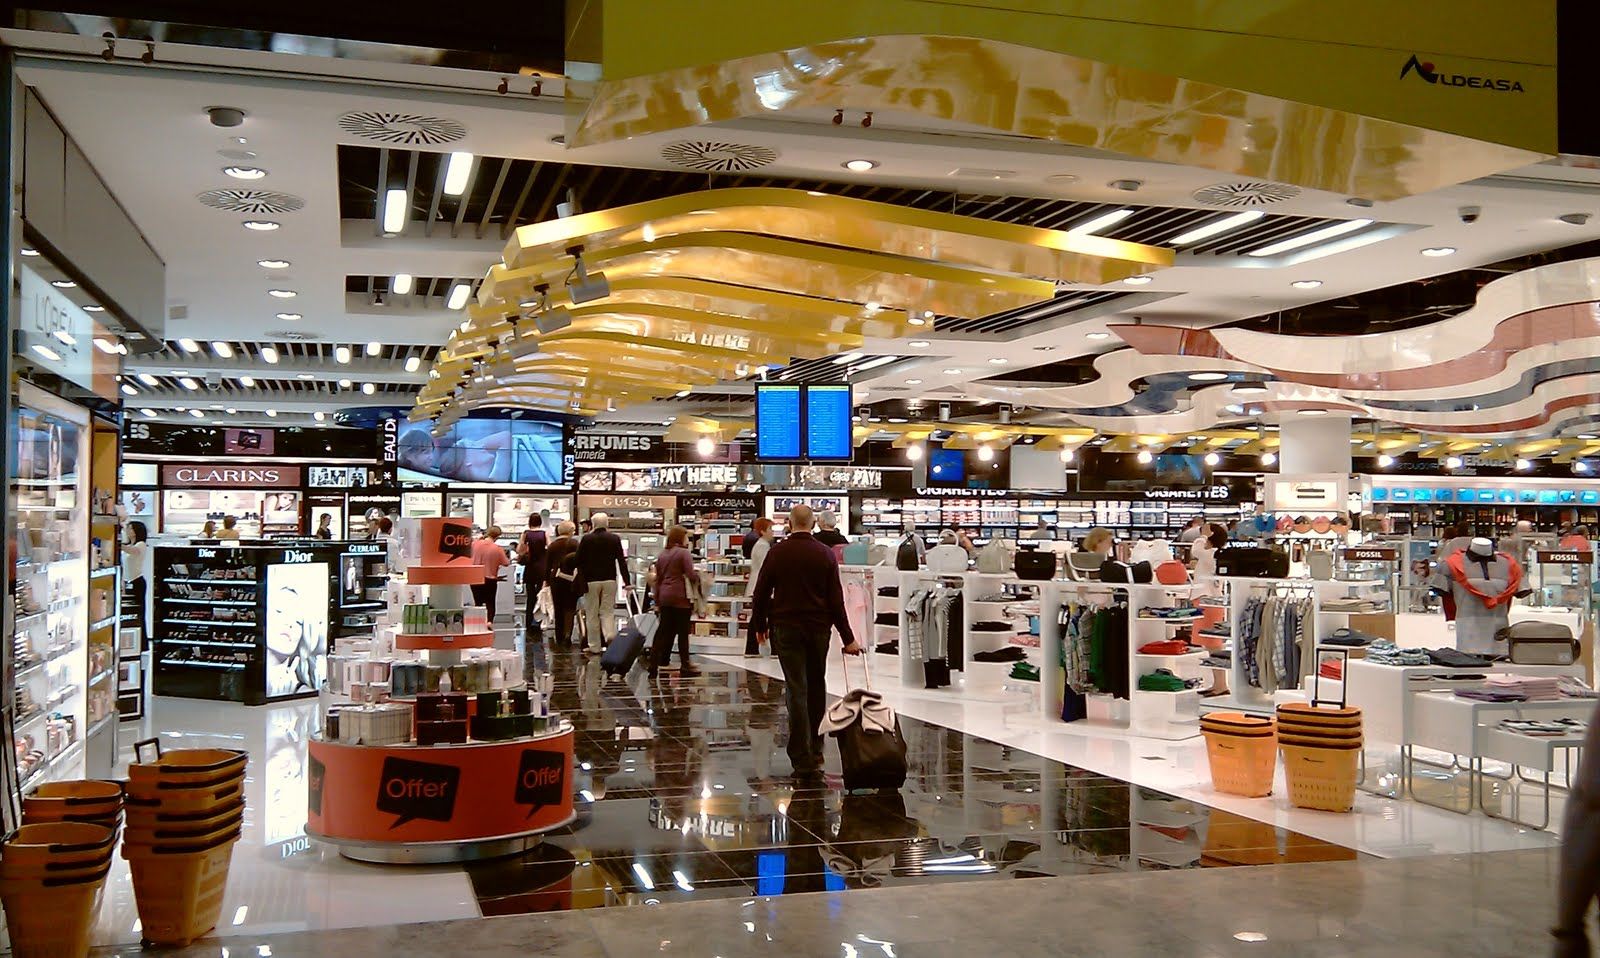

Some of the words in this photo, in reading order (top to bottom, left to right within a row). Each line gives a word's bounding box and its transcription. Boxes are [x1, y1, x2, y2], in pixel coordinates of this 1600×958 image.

[384, 434, 396, 461] EAU
[574, 436, 651, 450] RFUMES
[574, 449, 606, 460] umería
[565, 455, 574, 480] EAU
[176, 469, 279, 482] CLARINS
[660, 467, 685, 484] PAY
[687, 466, 738, 484] HERE
[444, 534, 472, 546] Offe
[198, 549, 216, 558] Dior
[284, 550, 314, 563] Dior
[1549, 553, 1579, 561] FOSSIL
[523, 767, 561, 789] Offer
[386, 778, 448, 799] Offer
